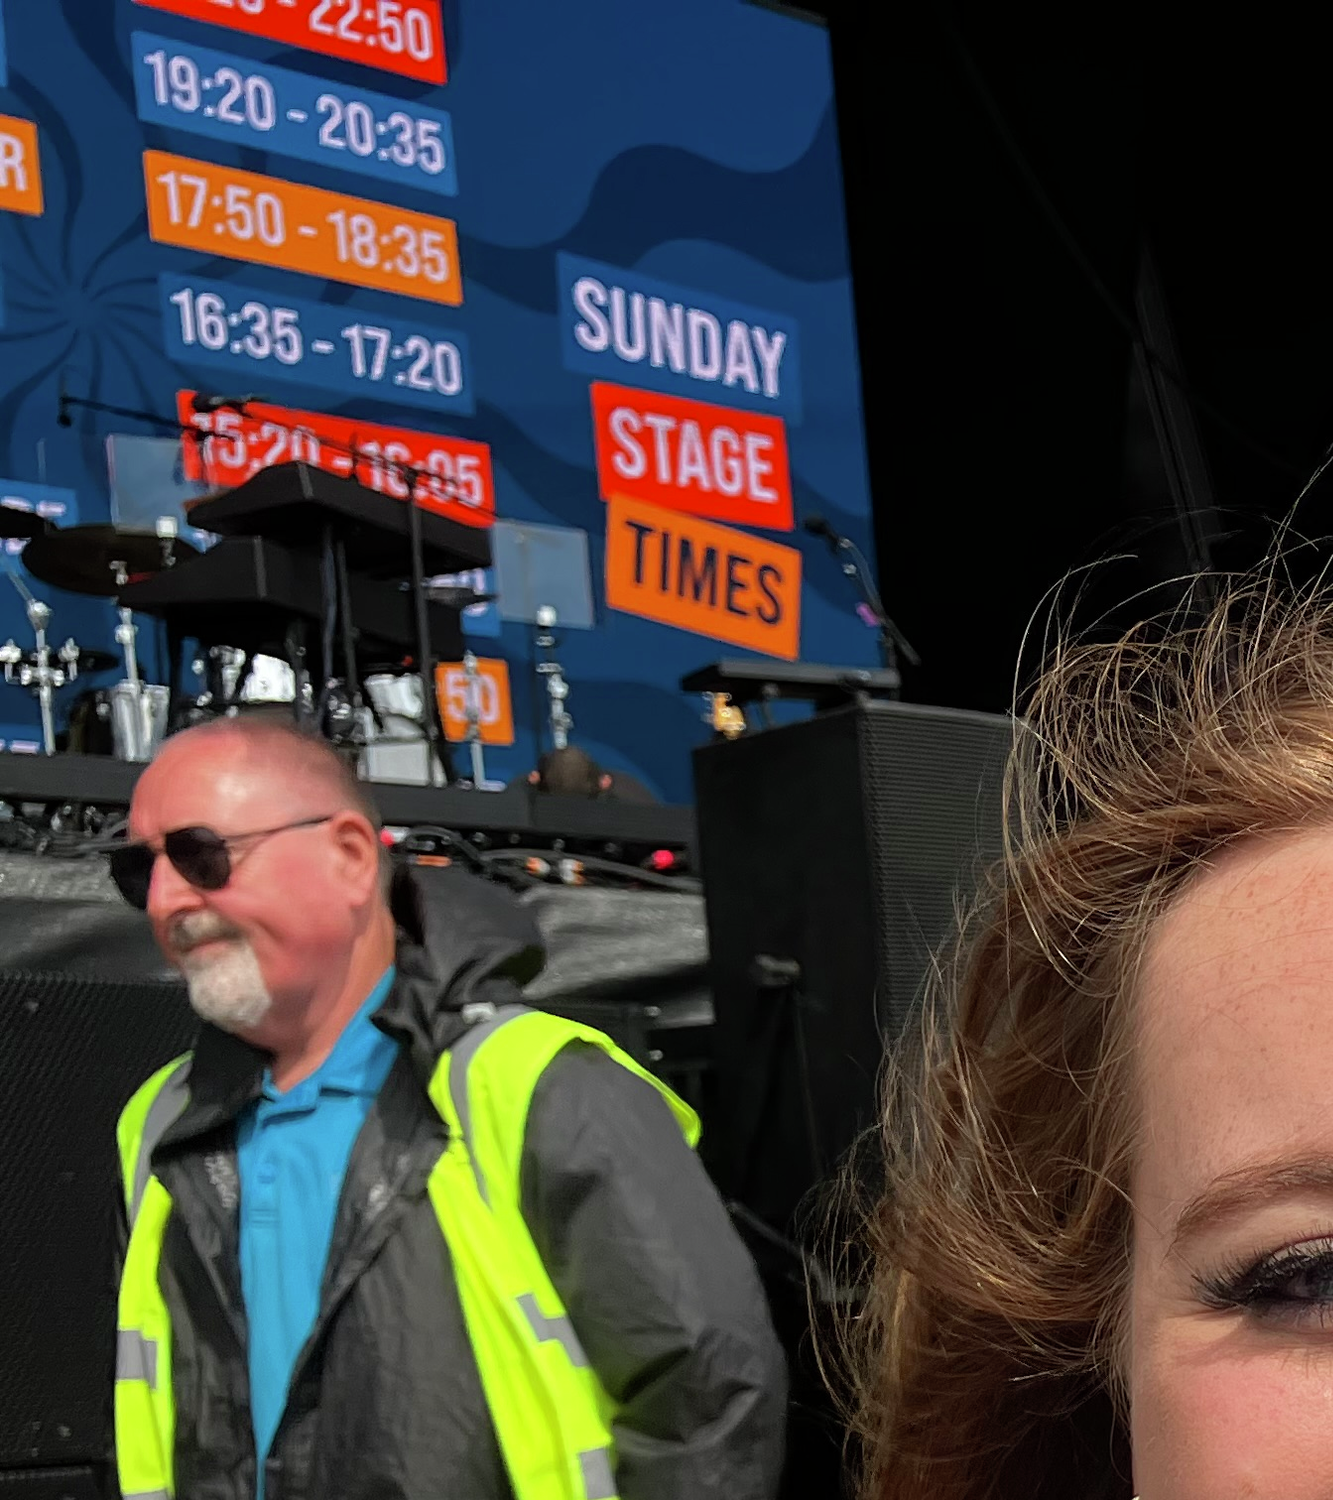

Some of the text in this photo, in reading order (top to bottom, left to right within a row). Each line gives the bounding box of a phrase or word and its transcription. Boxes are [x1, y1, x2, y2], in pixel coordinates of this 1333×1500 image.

[309, 0, 433, 61] 22:50
[144, 50, 276, 131] 19:20
[315, 94, 446, 174] 20:35
[157, 170, 286, 246] 17:50
[327, 210, 449, 283] 18:35
[170, 287, 303, 365] 16:35
[341, 323, 462, 395] 17:20
[572, 275, 787, 399] SUNDAY
[609, 407, 779, 503] STAGE
[625, 521, 784, 625] TIMES
